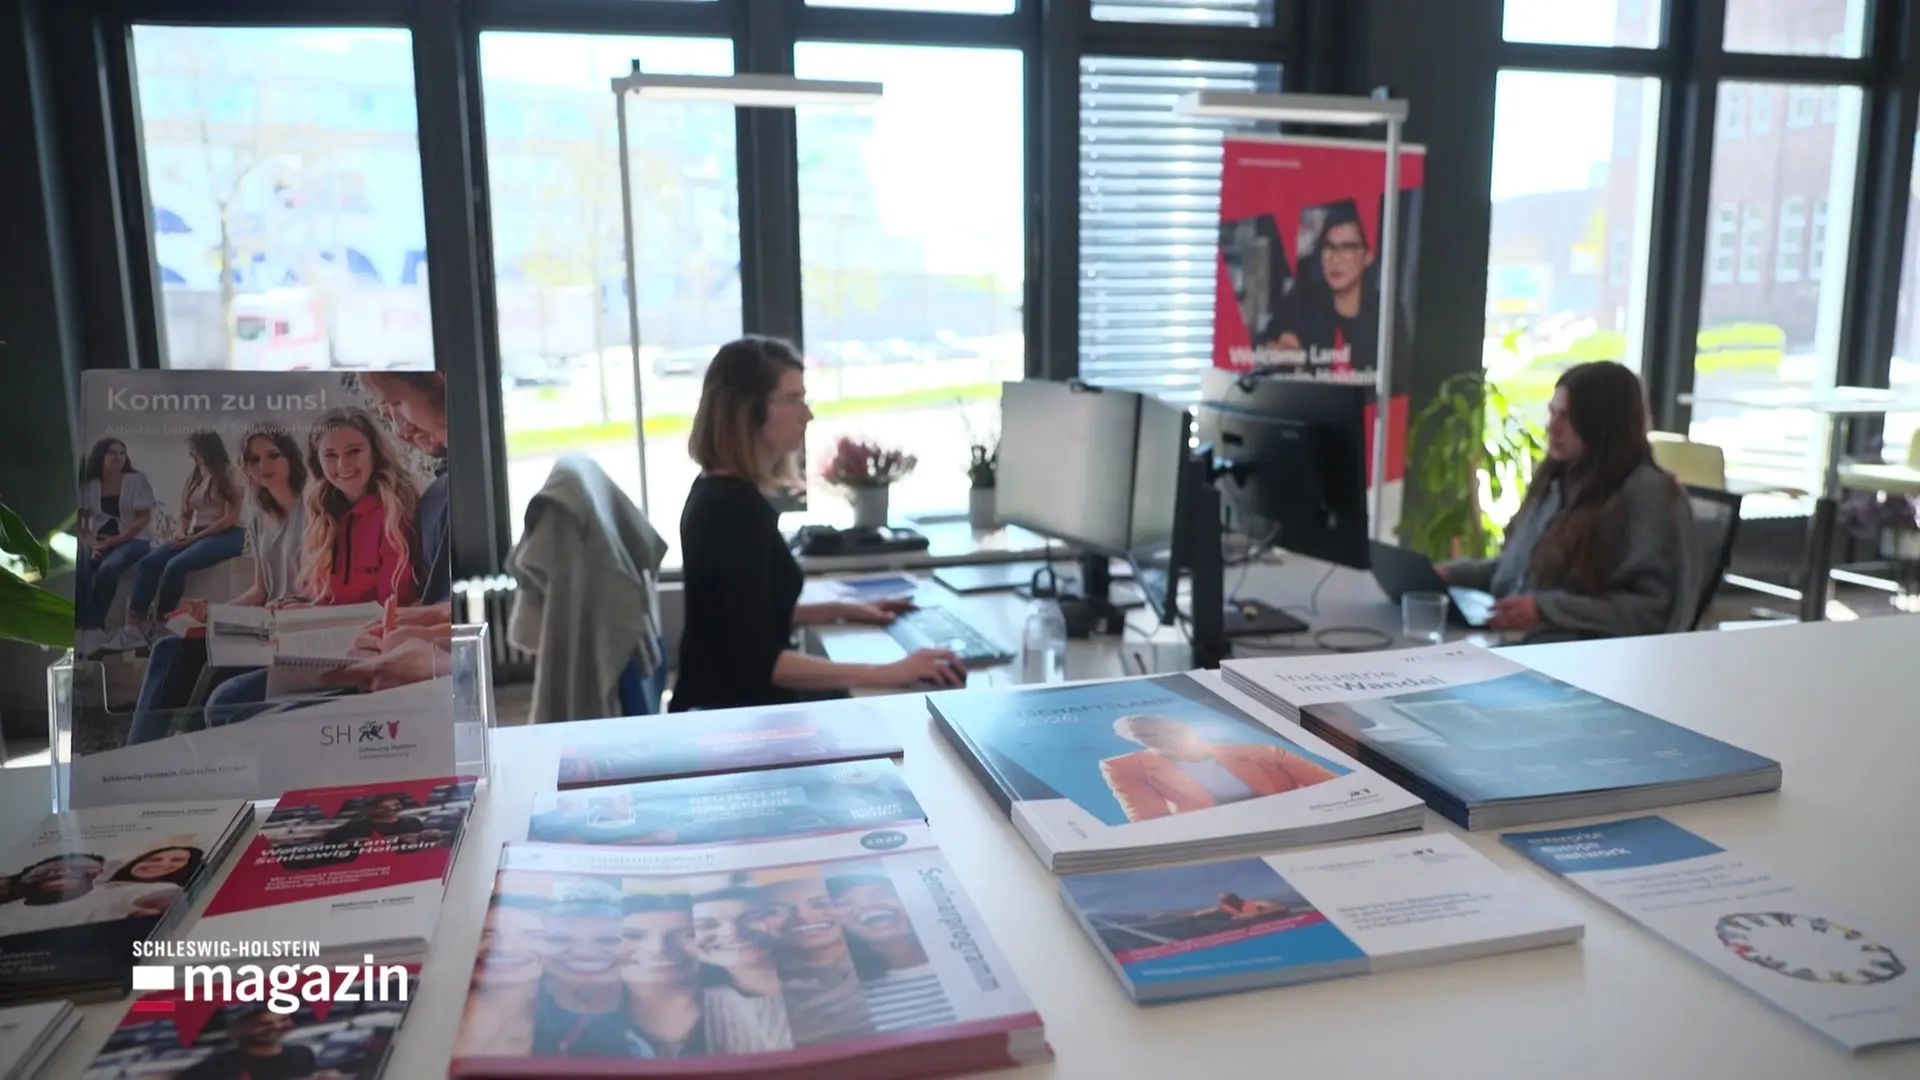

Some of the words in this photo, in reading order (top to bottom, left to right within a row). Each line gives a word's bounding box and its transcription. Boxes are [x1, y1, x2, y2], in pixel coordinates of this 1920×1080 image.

[1310, 344, 1351, 364] Land
[107, 388, 211, 411] Komm
[221, 395, 254, 411] zu
[266, 388, 327, 411] uns!
[1275, 669, 1398, 684] Industrie
[1296, 682, 1332, 693] im
[1334, 674, 1447, 692] Wandel
[319, 724, 351, 747] SH
[253, 841, 437, 866] Schleswig-Holstein
[260, 841, 349, 857] Welcome
[352, 836, 400, 849] Land
[1553, 846, 1633, 861] network
[917, 867, 1002, 994] Seminarprogramm
